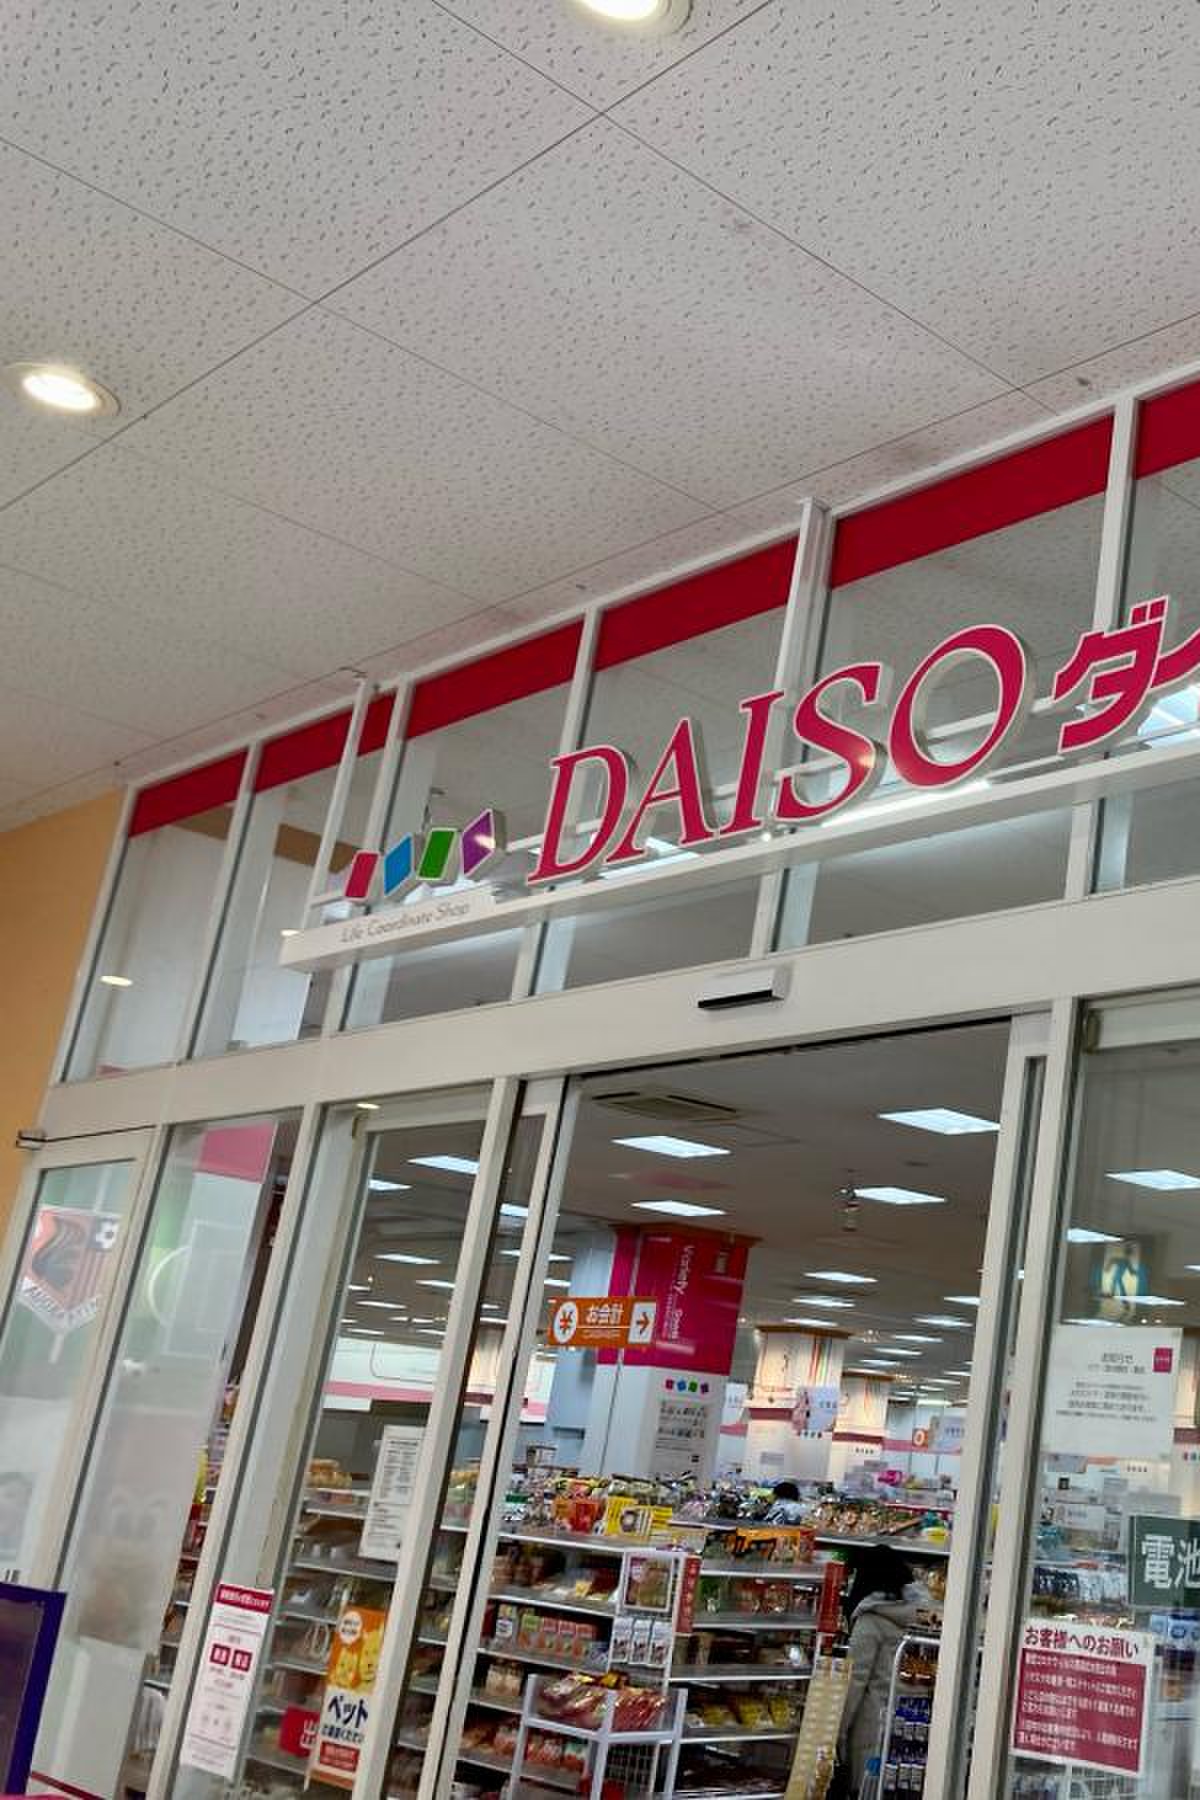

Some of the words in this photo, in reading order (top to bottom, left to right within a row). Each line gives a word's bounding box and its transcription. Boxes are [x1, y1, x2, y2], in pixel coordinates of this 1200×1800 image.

[527, 622, 1030, 885] DAISO
[340, 921, 363, 943] Life
[367, 911, 433, 936] Coordinate
[436, 902, 470, 921] Shop
[585, 1303, 624, 1325] お会計
[1024, 1626, 1139, 1659] お客様へのお願い
